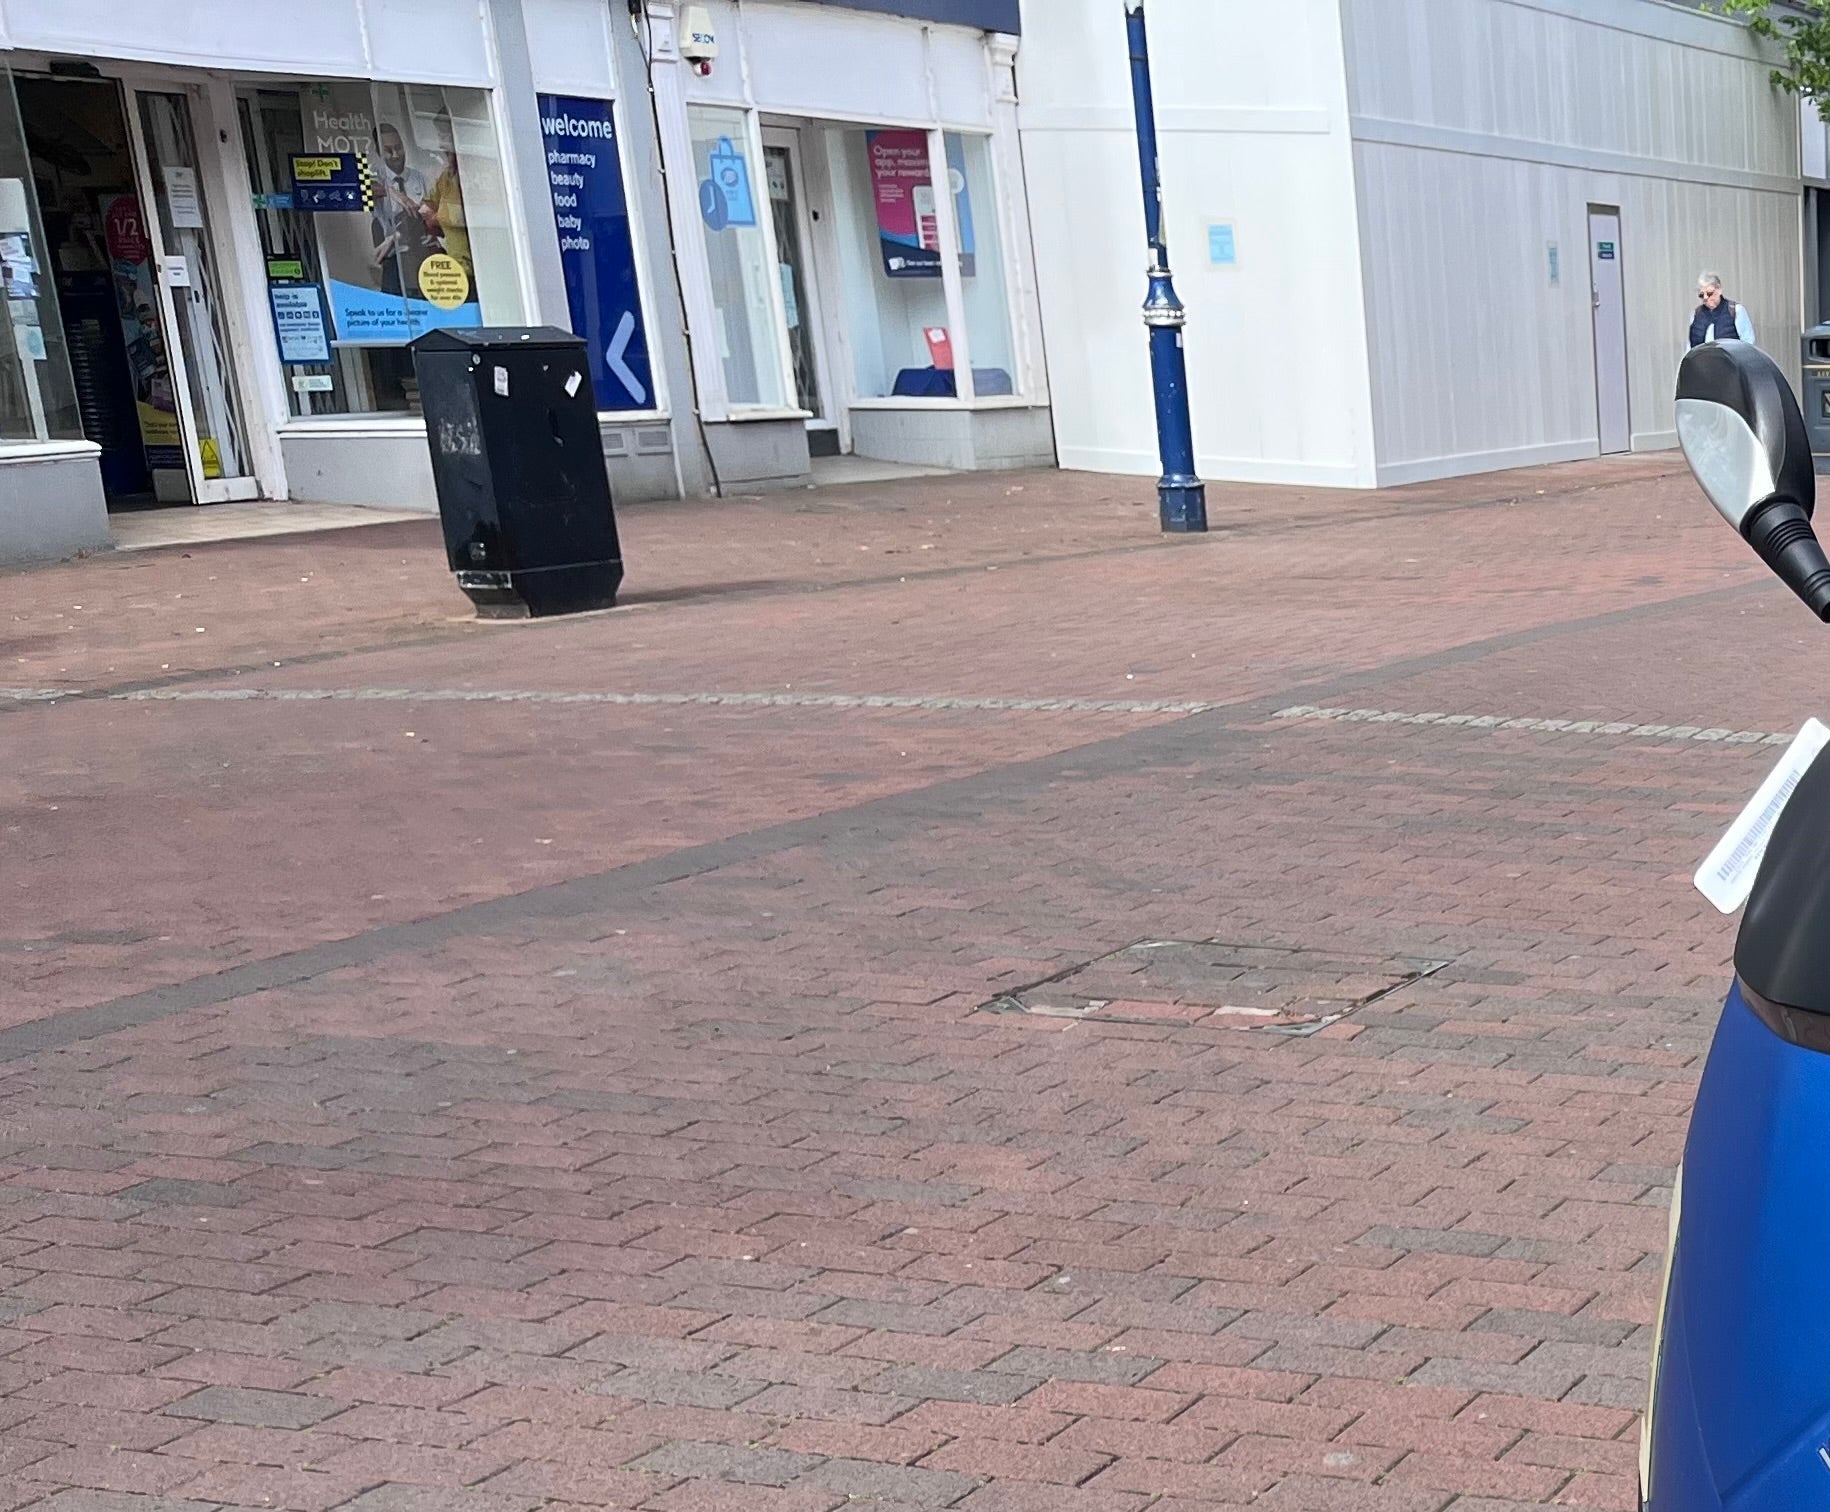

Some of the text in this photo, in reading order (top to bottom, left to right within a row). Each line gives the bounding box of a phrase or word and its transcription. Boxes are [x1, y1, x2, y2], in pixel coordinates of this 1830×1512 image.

[313, 111, 371, 130] Health
[542, 113, 613, 139] welcome
[317, 135, 371, 154] MOT?
[548, 150, 596, 168] pharmacy
[551, 171, 584, 189] beauty
[554, 193, 577, 207] food
[557, 214, 582, 231] baby
[561, 235, 590, 252] photo
[430, 260, 452, 270] FREE
